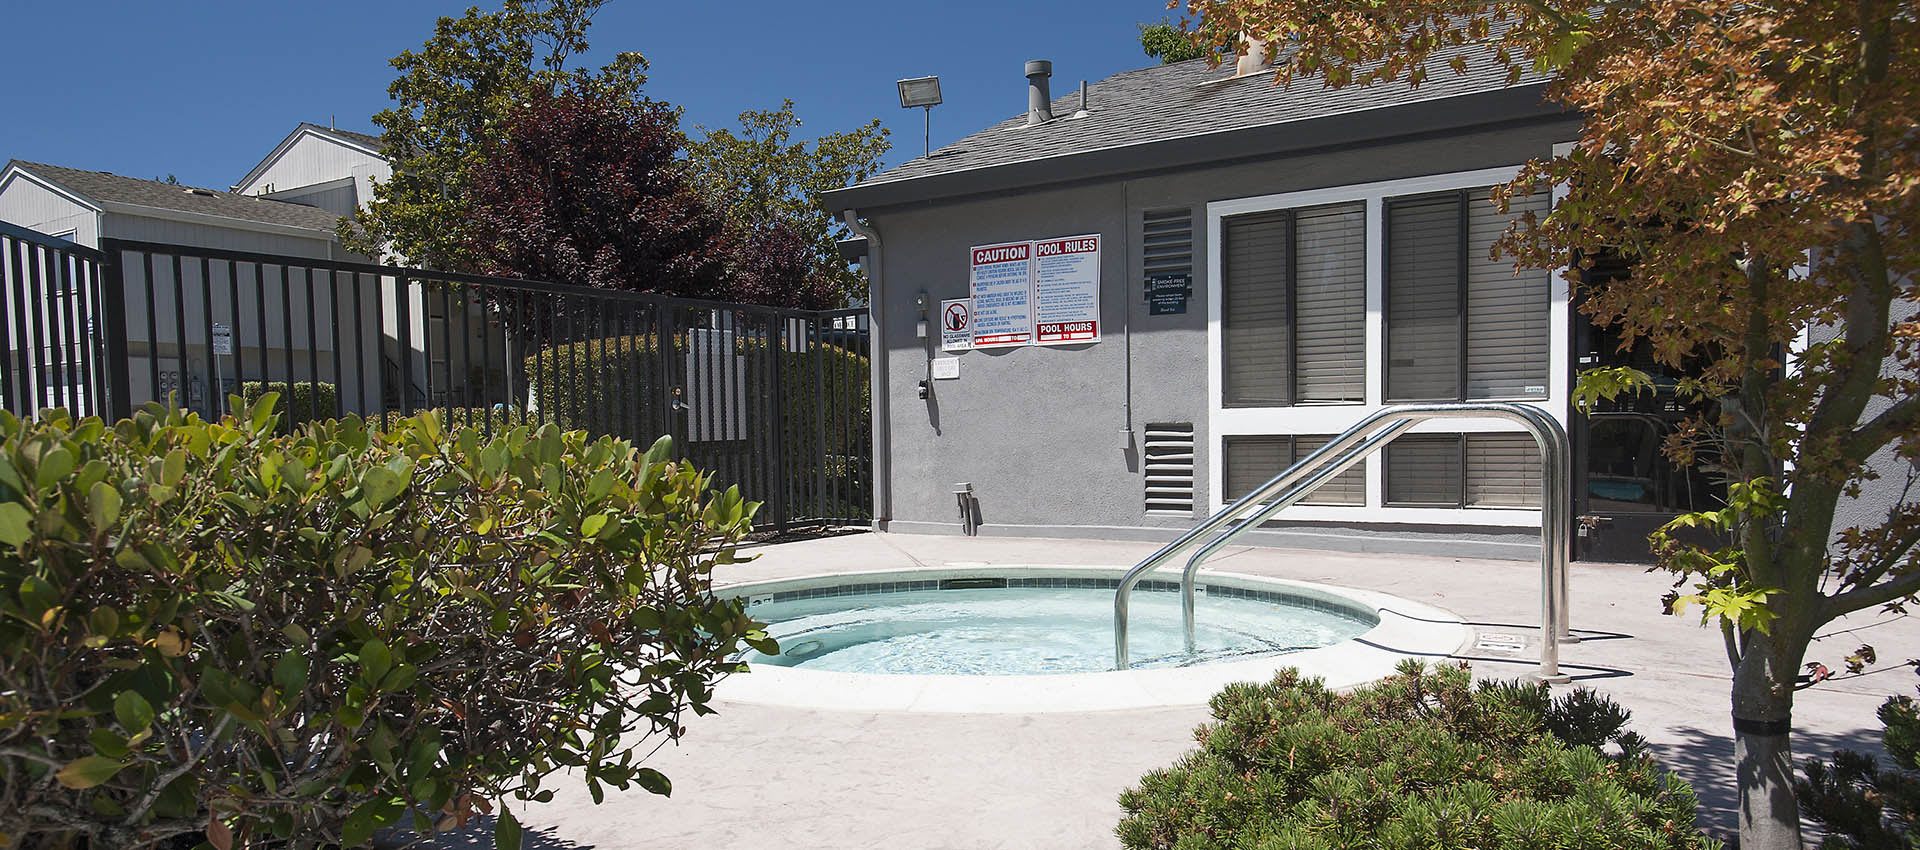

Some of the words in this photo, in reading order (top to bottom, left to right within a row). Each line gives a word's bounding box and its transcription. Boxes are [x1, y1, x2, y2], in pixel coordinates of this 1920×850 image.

[976, 246, 1026, 263] CAUTION
[1038, 243, 1062, 256] POOL
[1065, 240, 1096, 253] RULES
[1040, 324, 1062, 333] POOL
[1064, 322, 1093, 332] HOURS
